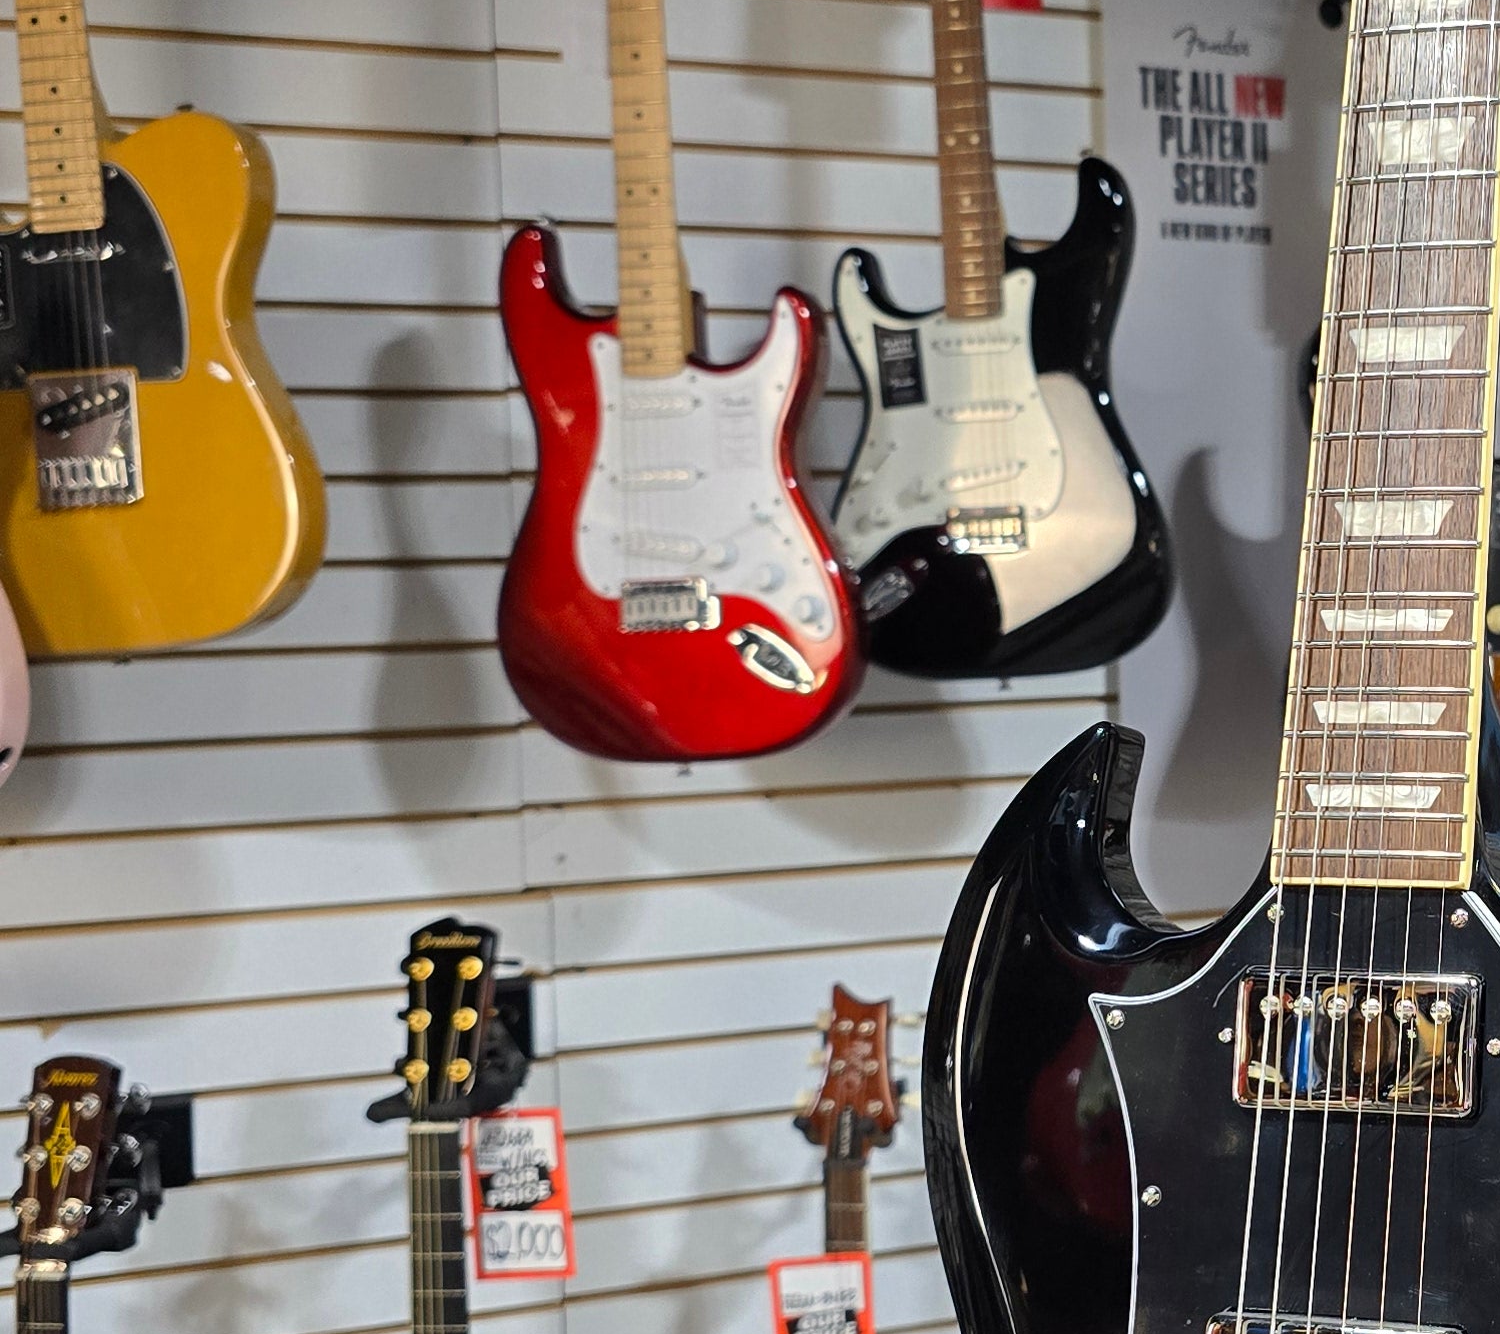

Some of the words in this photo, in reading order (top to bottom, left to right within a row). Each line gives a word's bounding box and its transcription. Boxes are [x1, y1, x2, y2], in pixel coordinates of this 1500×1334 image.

[1172, 26, 1251, 58] Fender
[1139, 65, 1182, 112] THE
[1188, 70, 1228, 114] ALL
[1233, 74, 1285, 119] NEW
[1159, 115, 1246, 161] PLAYER
[1173, 163, 1258, 209] SERIES
[486, 1180, 552, 1208] PRICE
[490, 1168, 539, 1189] OUR
[486, 1220, 566, 1262] $2,000
[796, 1311, 846, 1332] OUR
